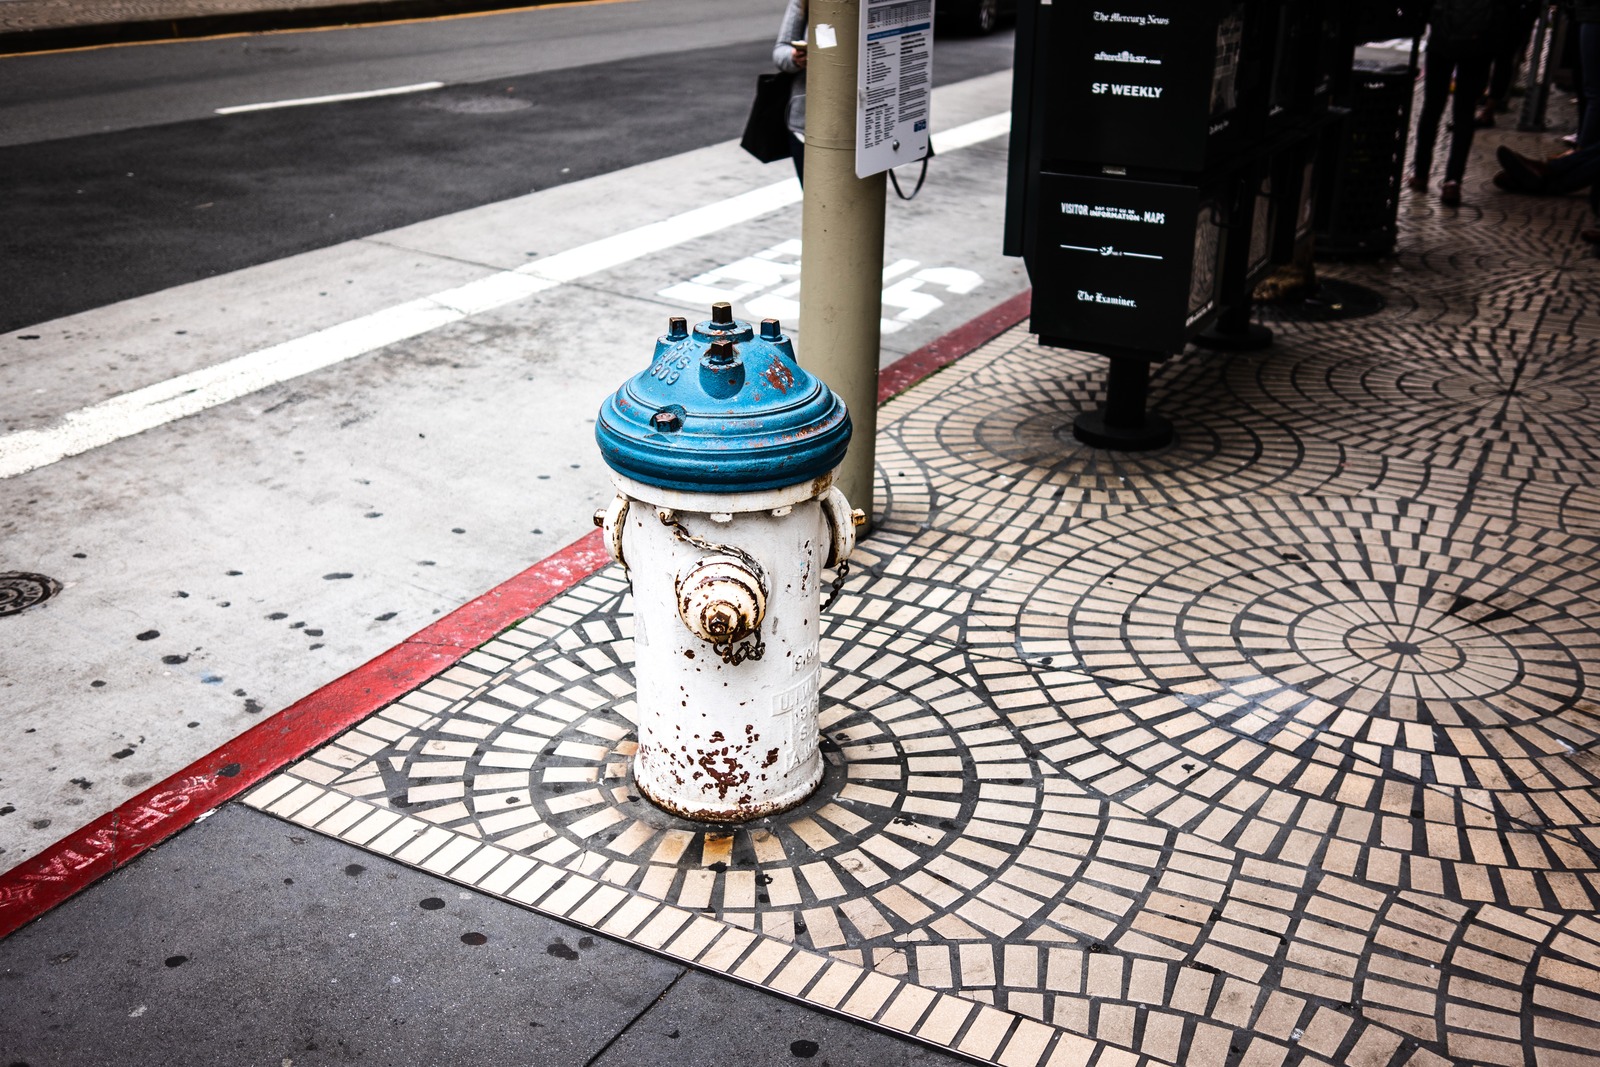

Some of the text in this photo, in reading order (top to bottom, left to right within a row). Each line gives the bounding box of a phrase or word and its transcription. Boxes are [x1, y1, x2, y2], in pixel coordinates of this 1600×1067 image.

[1093, 11, 1170, 26] The Mercury News
[1091, 82, 1163, 98] SF WEEKLY
[1061, 202, 1165, 225] VISITOR INFORMATION MAPS
[1077, 289, 1137, 308] The Examiner.
